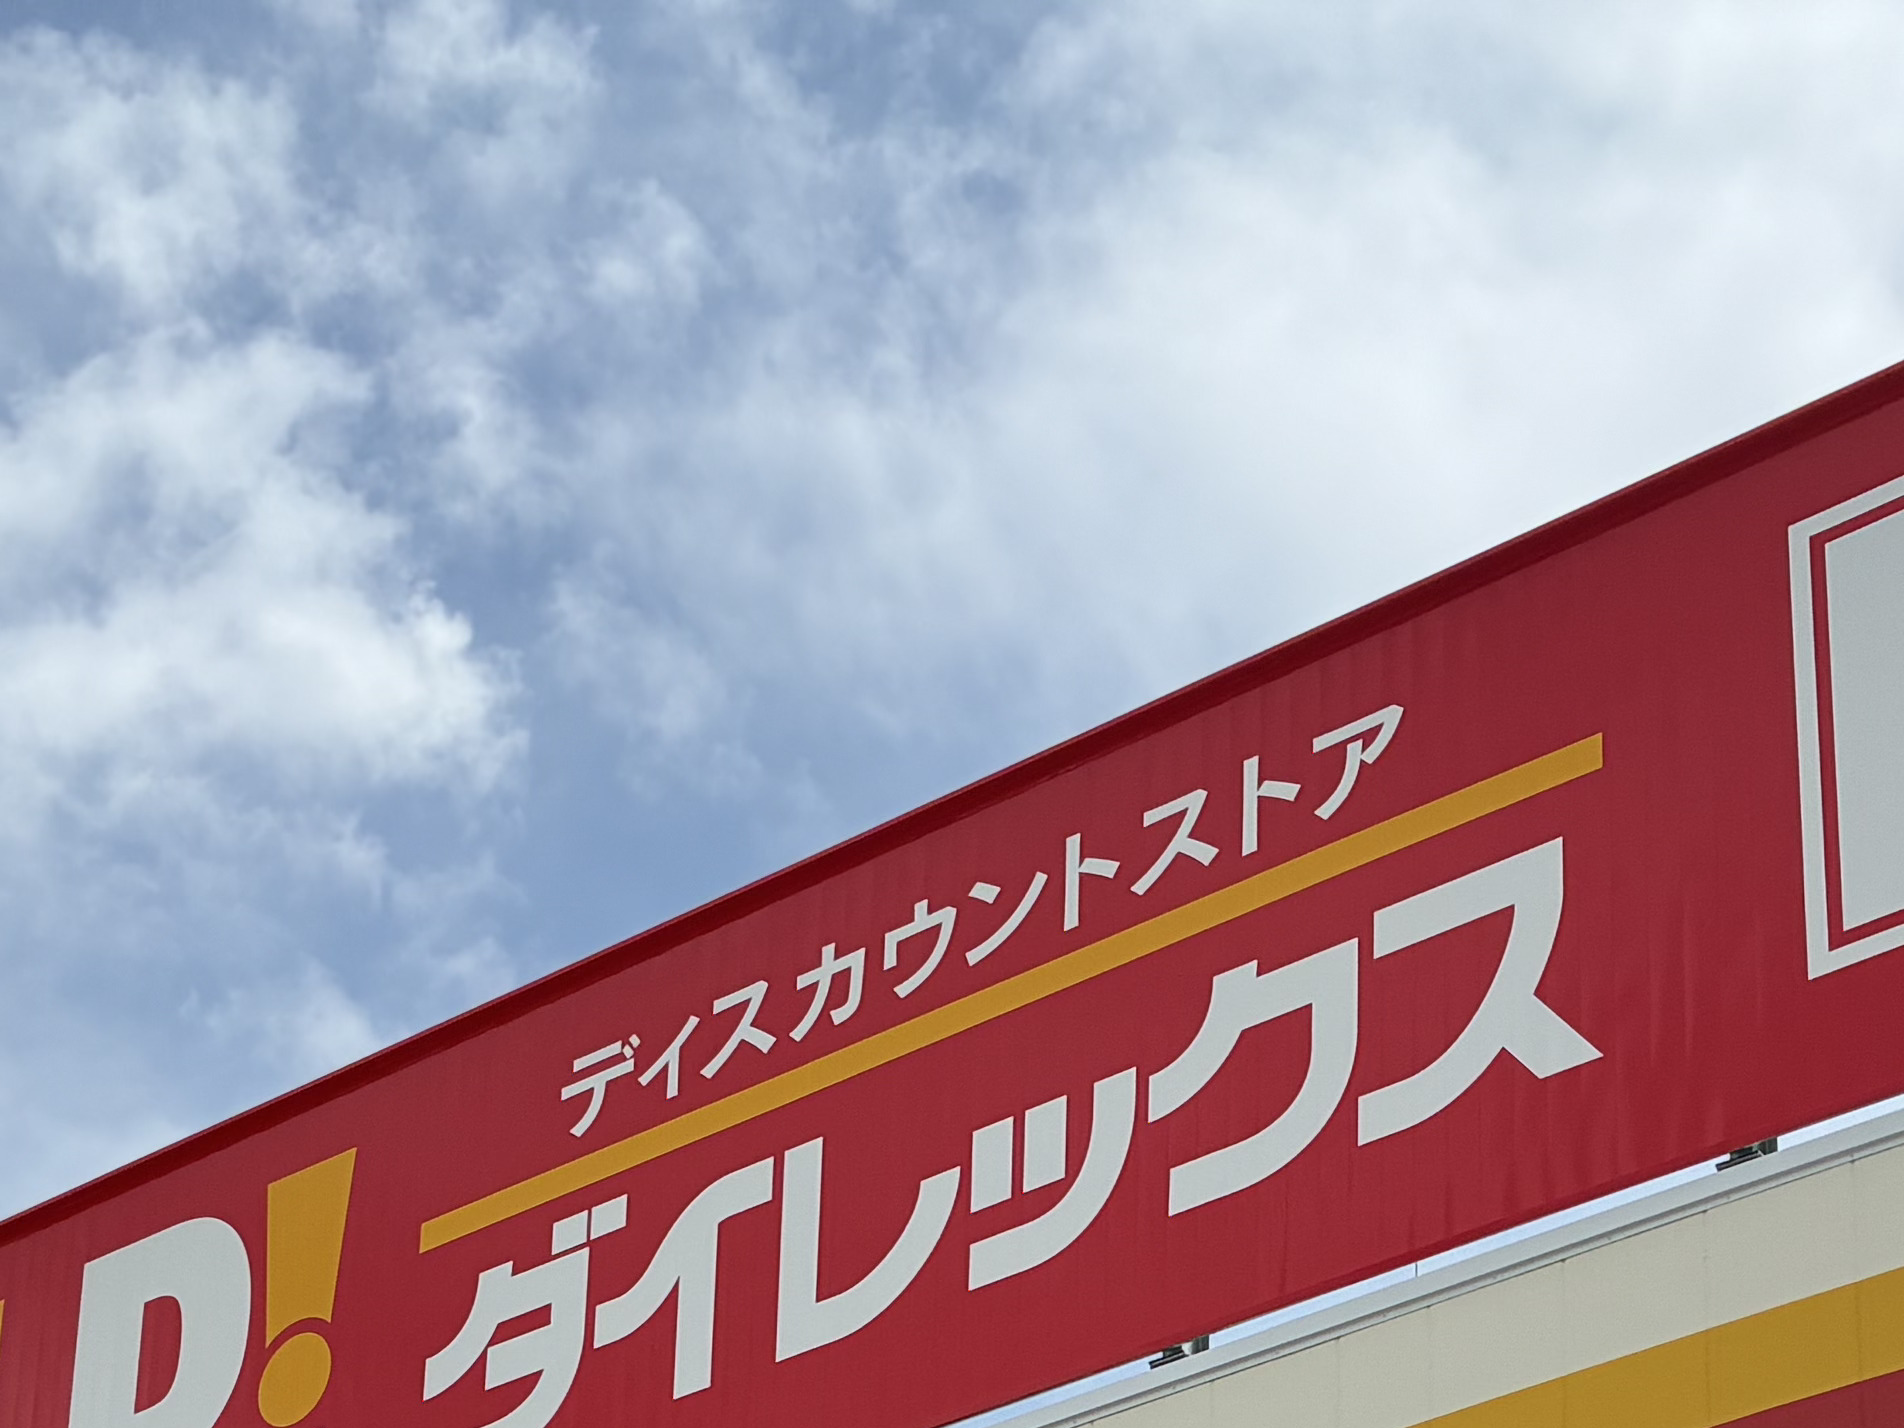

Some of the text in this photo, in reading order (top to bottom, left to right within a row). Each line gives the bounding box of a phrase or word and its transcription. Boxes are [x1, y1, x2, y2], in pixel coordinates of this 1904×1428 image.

[561, 705, 1404, 1137] ディスカウントストア
